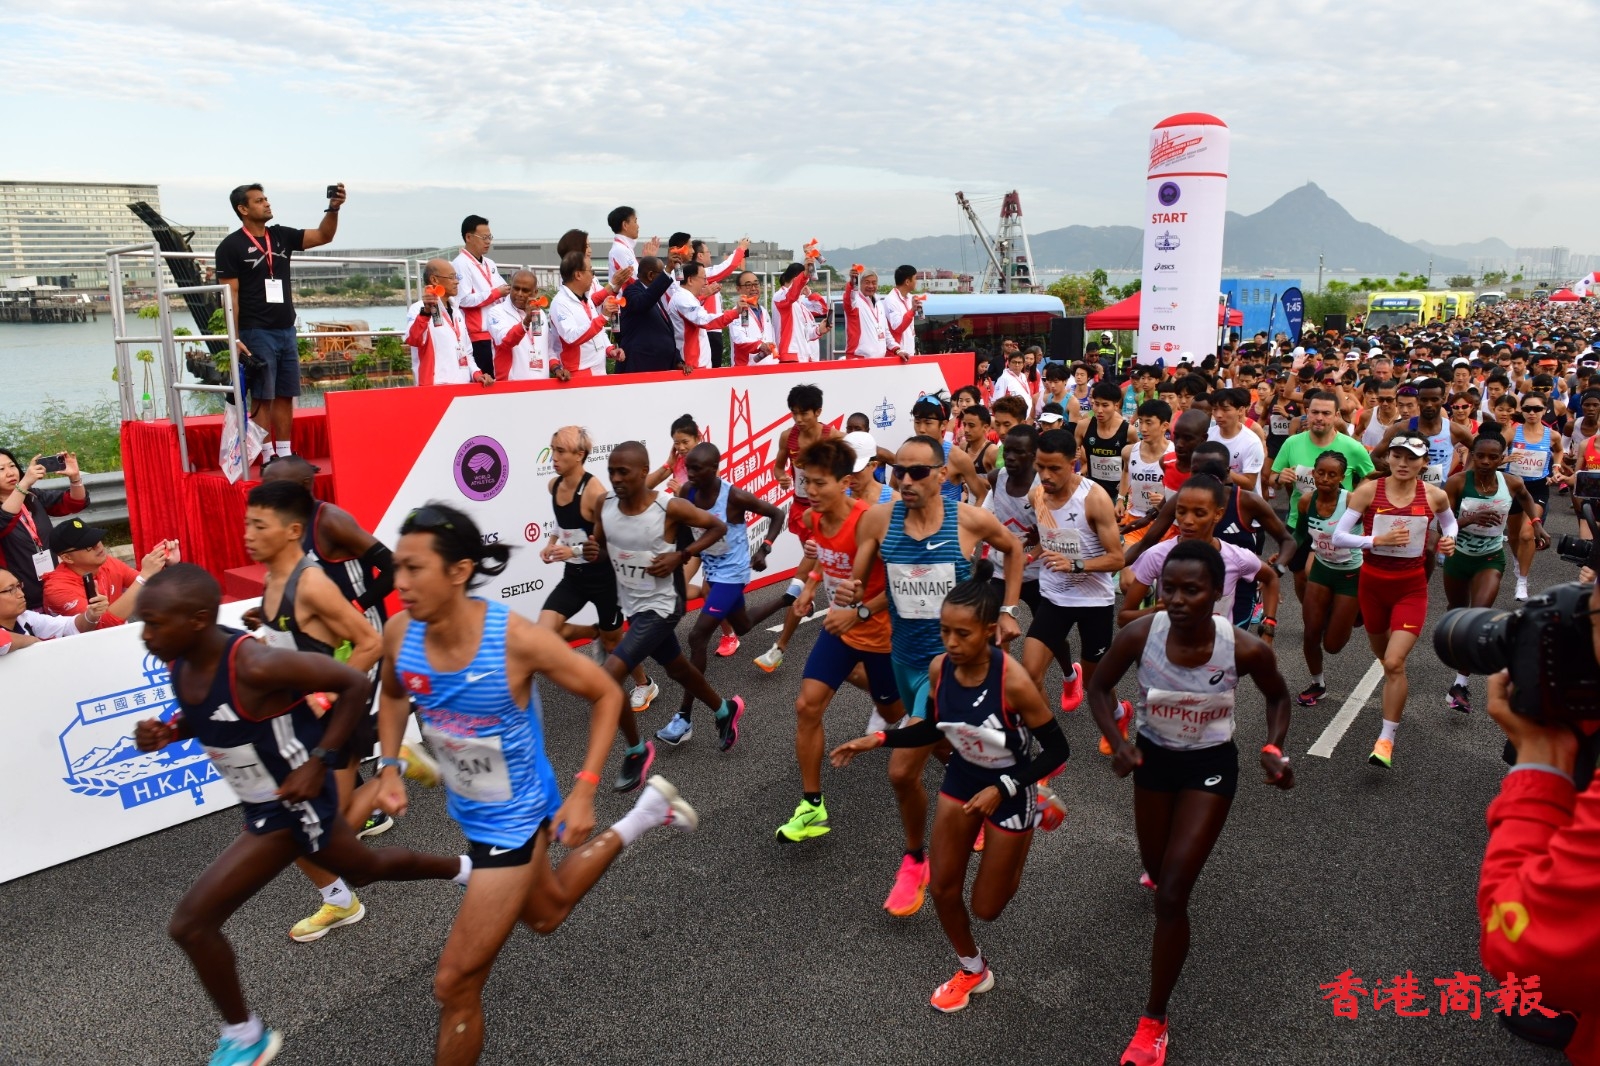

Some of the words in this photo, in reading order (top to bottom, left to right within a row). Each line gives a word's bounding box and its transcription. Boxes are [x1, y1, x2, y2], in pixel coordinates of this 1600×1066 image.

[1152, 213, 1188, 224] START
[1286, 302, 1302, 312] 1:45
[1093, 463, 1120, 472] LEONG
[1132, 473, 1164, 482] KOREA
[1296, 475, 1315, 485] MAA
[501, 579, 544, 598] SEIKO
[94, 685, 175, 716] 中國香港
[1151, 704, 1230, 724] KIPKIRUI
[1183, 725, 1198, 733] 23
